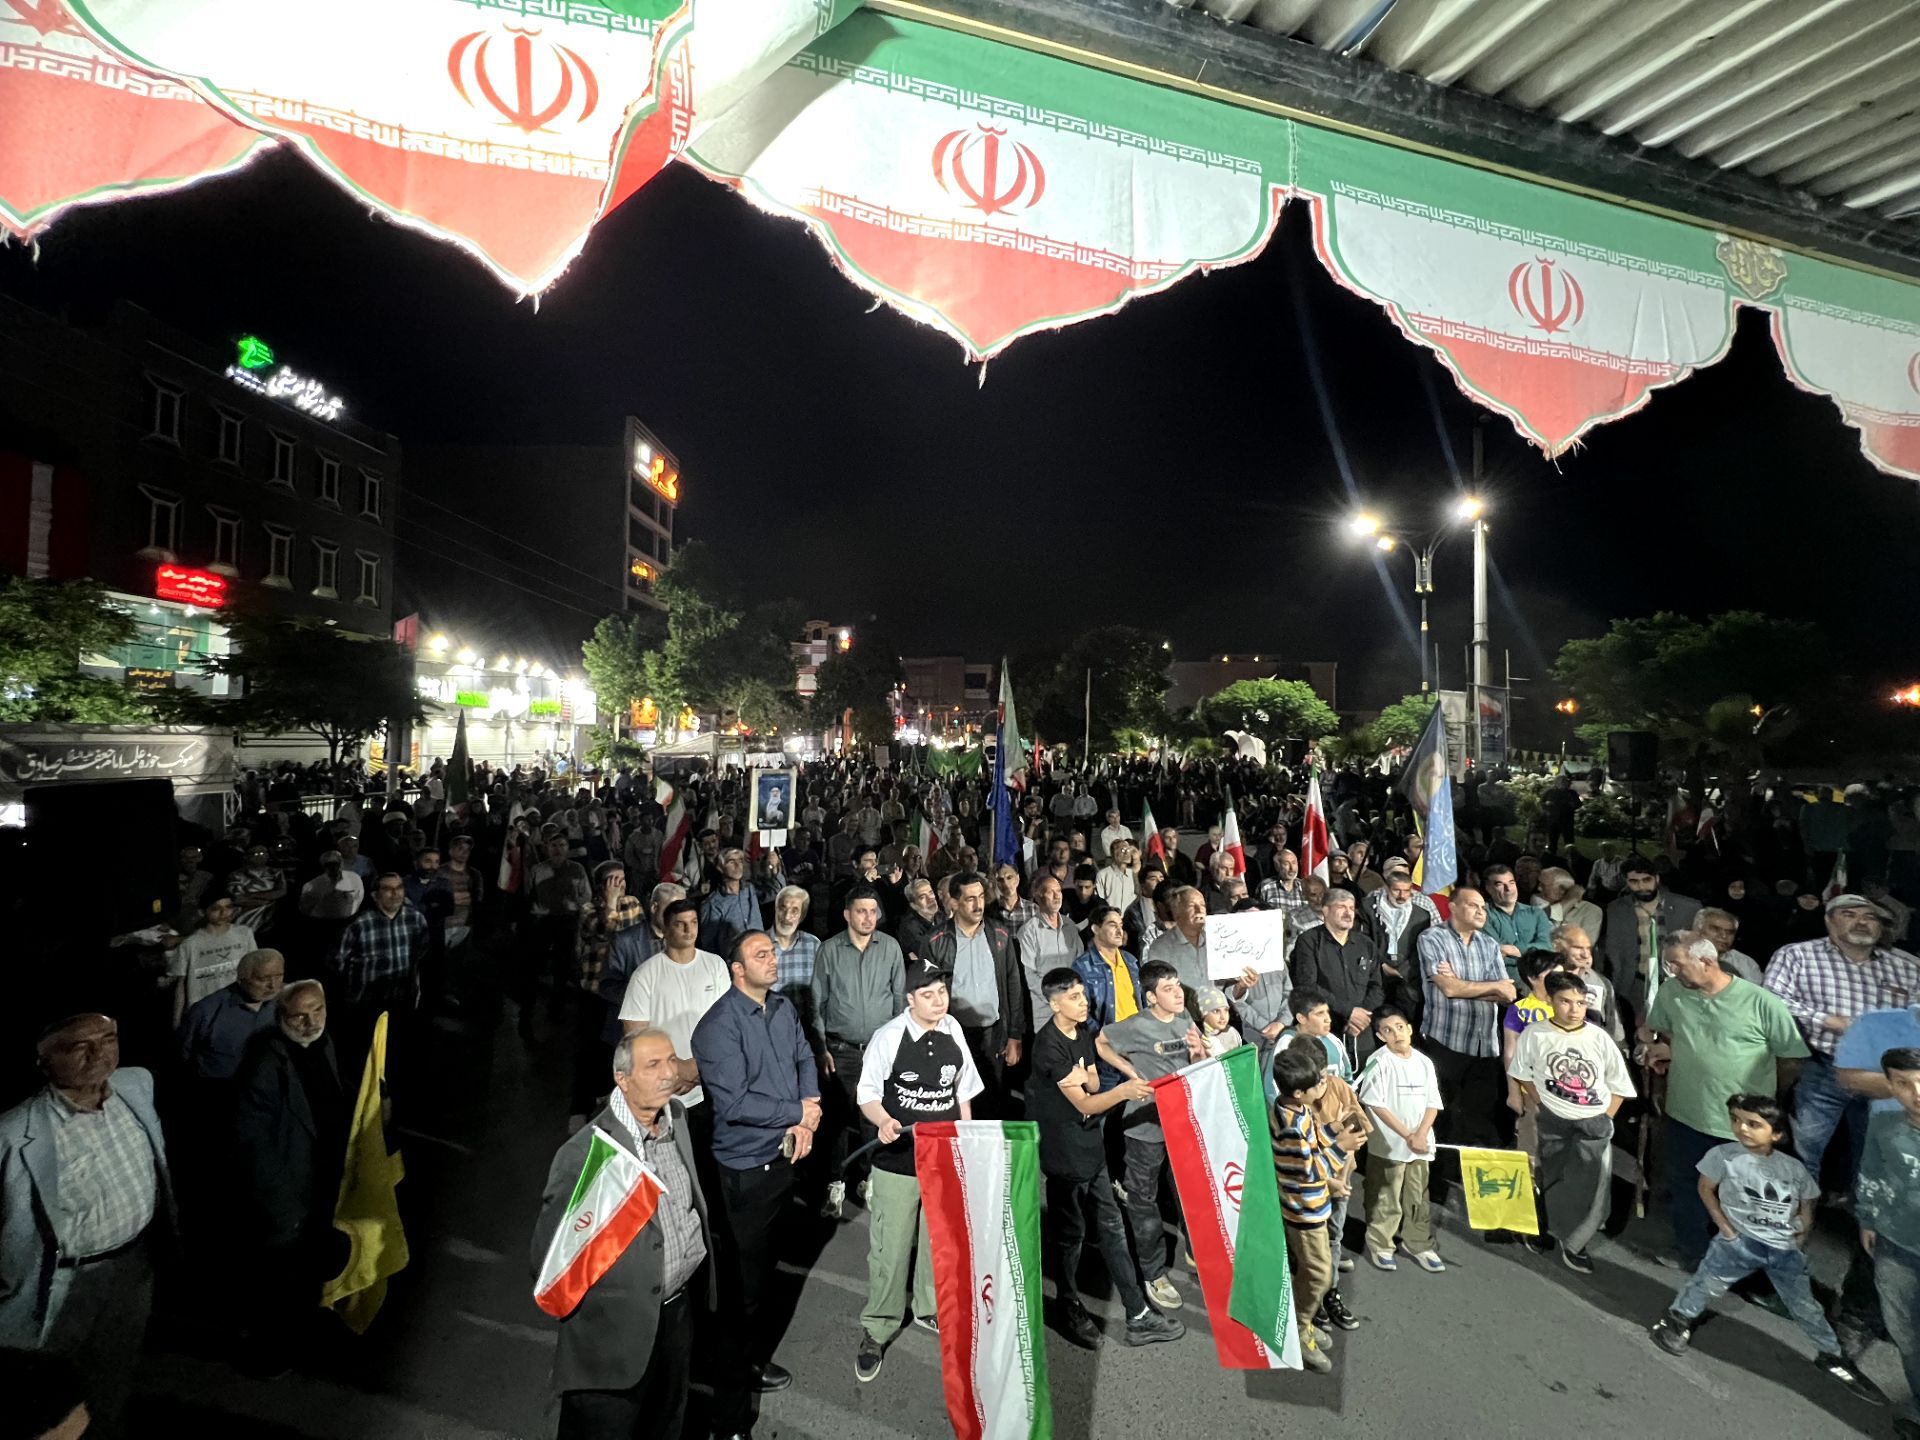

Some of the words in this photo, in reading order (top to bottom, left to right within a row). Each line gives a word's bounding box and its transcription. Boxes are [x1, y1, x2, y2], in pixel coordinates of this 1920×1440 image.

[17, 751, 62, 779] صادق
[54, 748, 116, 774] جعفر
[138, 752, 160, 769] حوزه
[157, 739, 198, 773] موکب
